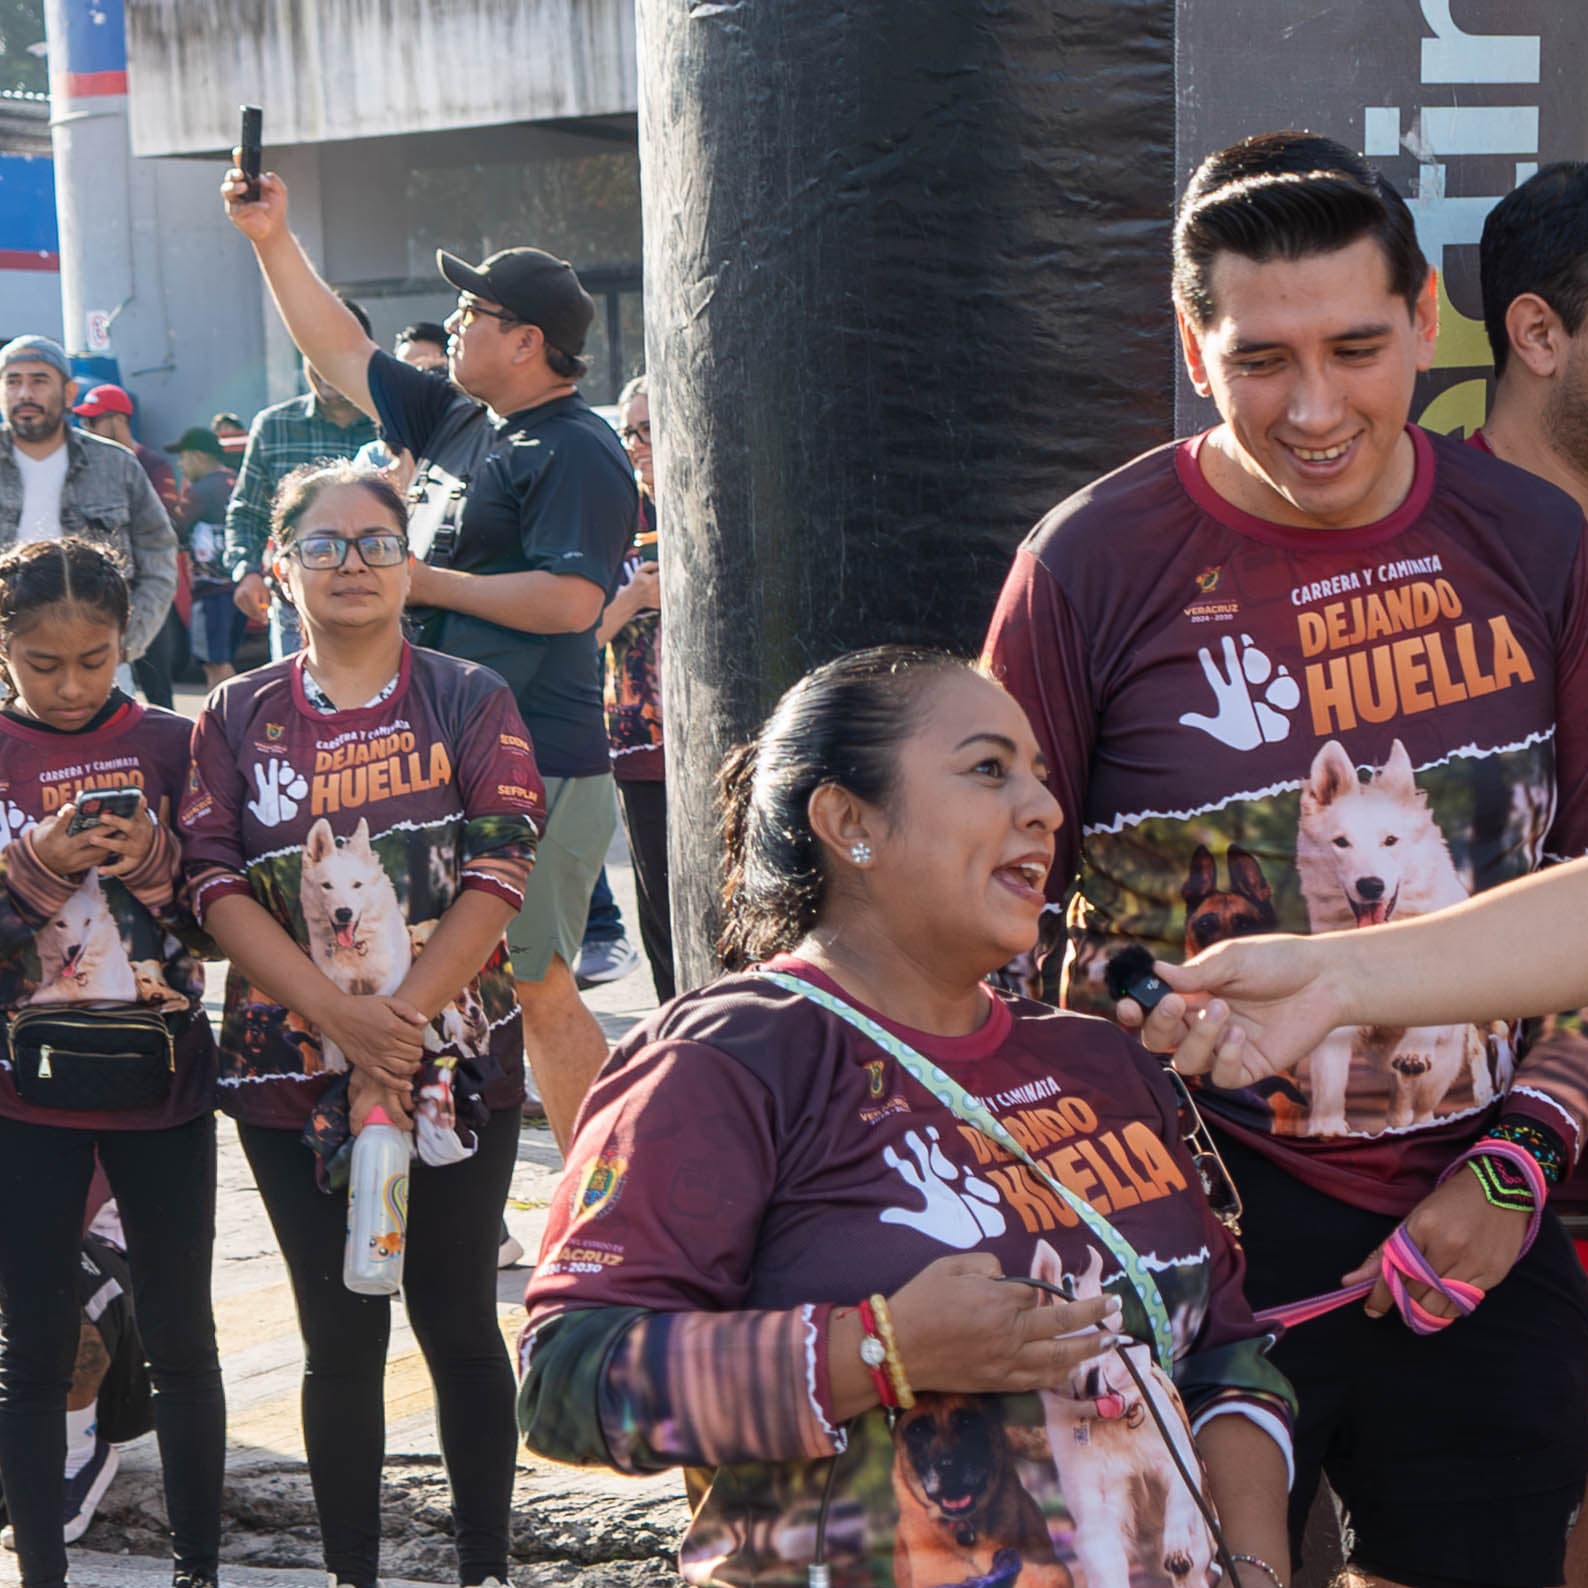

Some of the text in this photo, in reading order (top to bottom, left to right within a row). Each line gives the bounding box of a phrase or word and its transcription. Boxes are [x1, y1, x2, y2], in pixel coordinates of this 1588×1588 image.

[1291, 554, 1442, 606] CARRERA Y CAMINATA
[1183, 603, 1239, 616] VERACRUZ
[1297, 578, 1462, 658] DEJANDO
[1304, 614, 1536, 737] HUELLA
[39, 757, 140, 783] CARRERA Y CAMINATA
[315, 732, 415, 773] DEJANDO
[311, 742, 452, 815] HUELLA
[995, 1076, 1061, 1106] CAMINATA
[559, 1247, 624, 1266] ACRUZ
